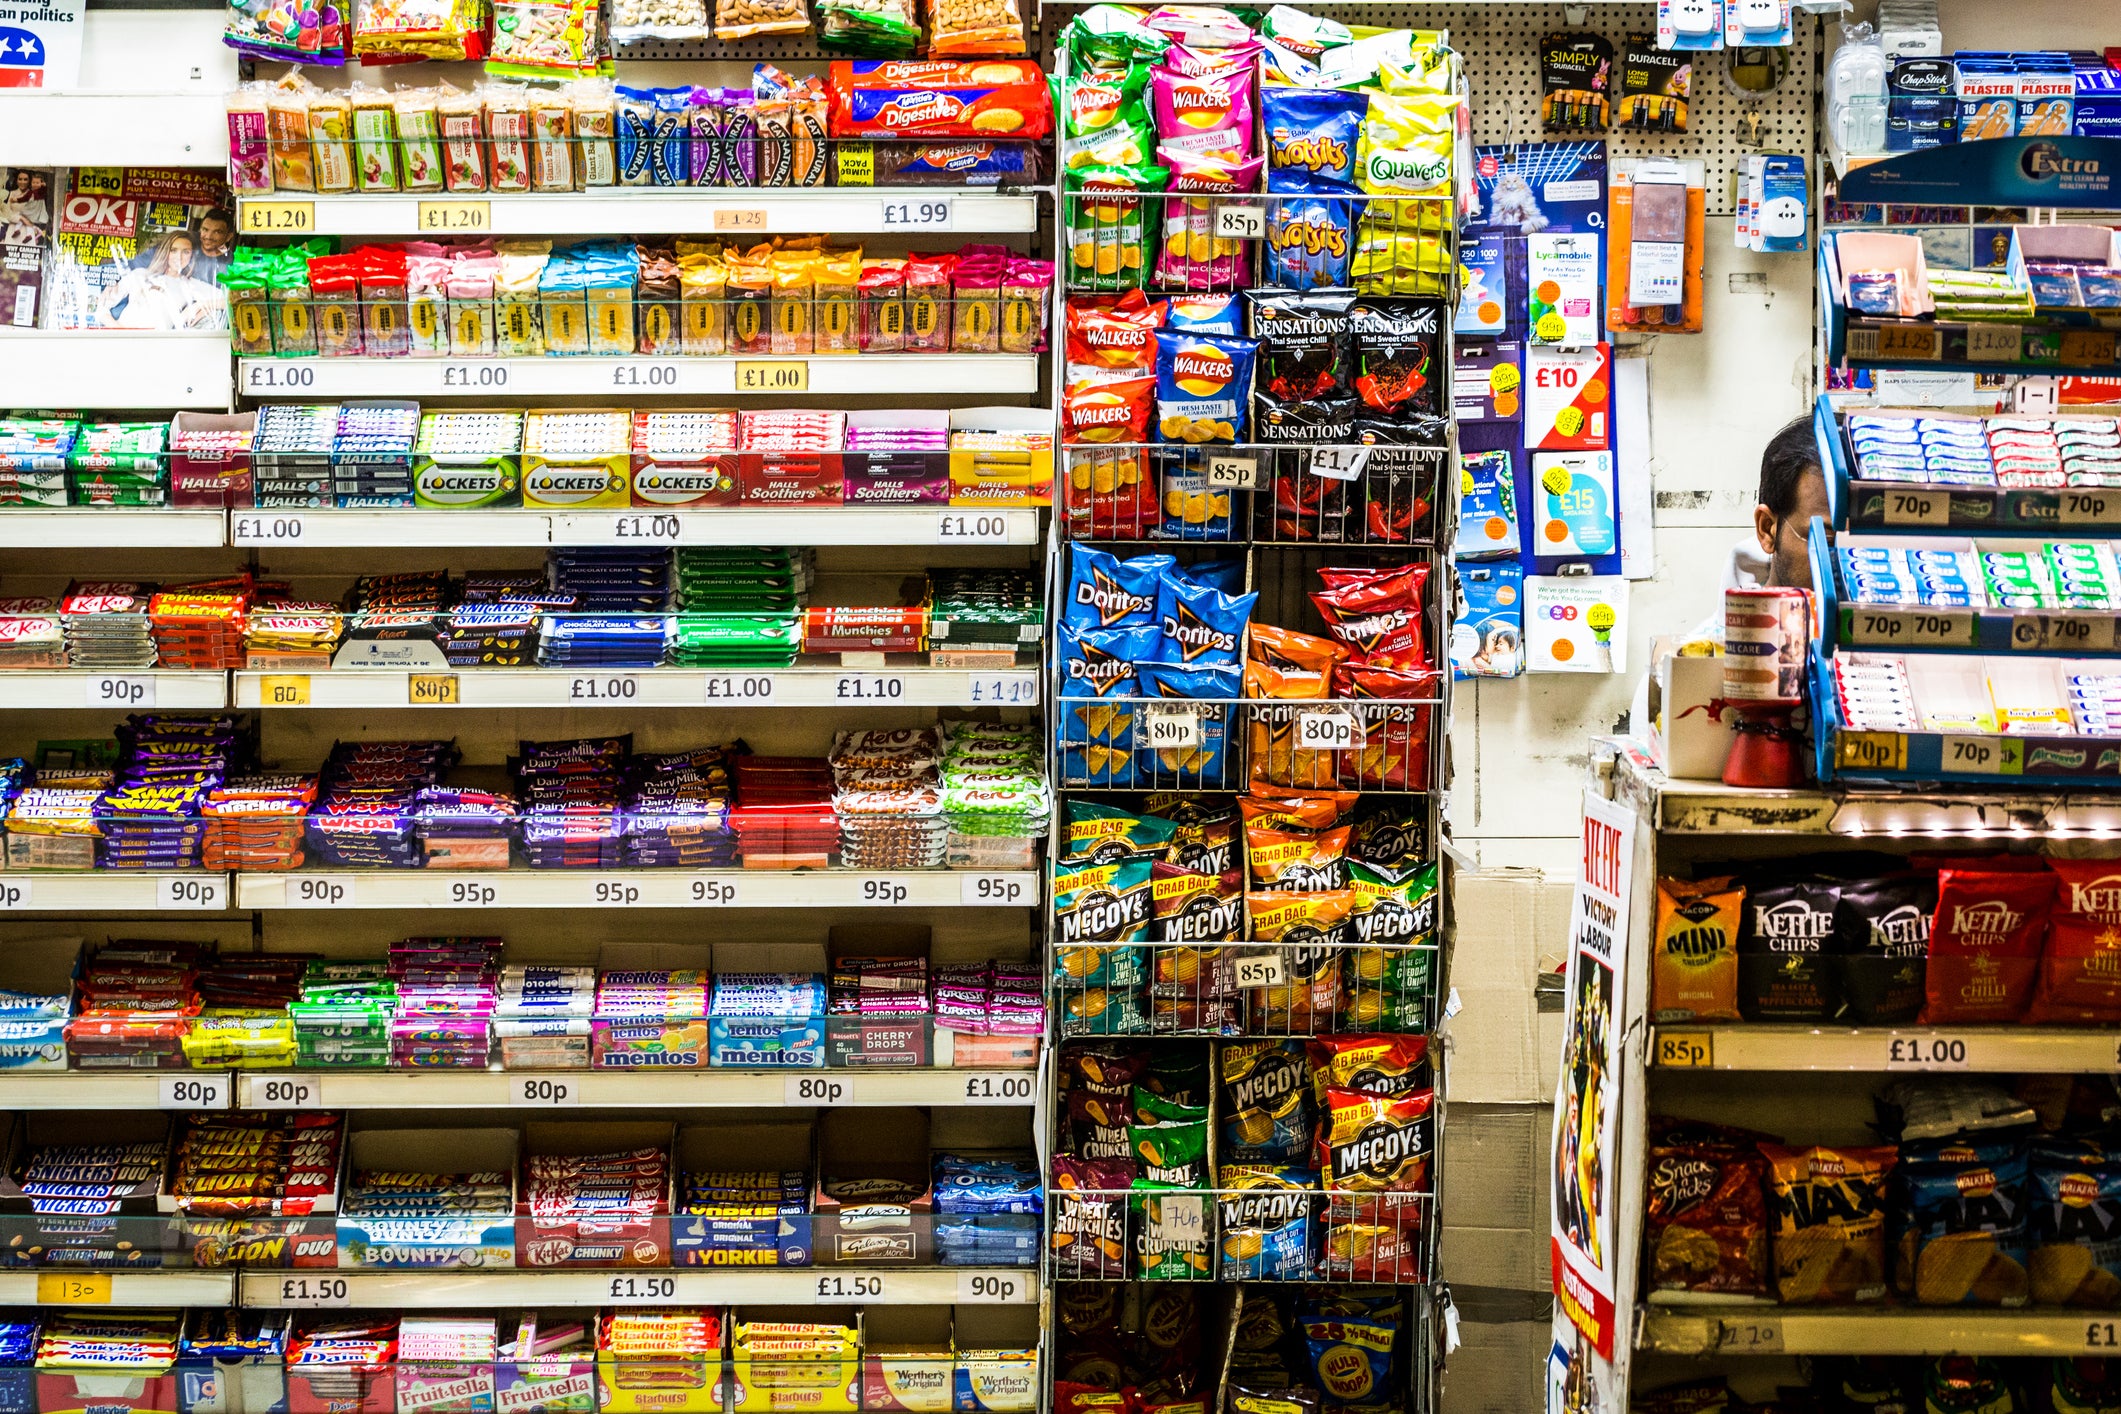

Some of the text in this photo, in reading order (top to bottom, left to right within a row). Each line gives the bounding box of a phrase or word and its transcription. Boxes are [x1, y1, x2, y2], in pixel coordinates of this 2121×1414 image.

[20, 8, 74, 23] politics
[1550, 51, 1599, 66] SIMPLY
[1629, 54, 1678, 66] DURACELL
[886, 62, 957, 79] Digestives
[1900, 74, 1947, 85] ChapStick
[1964, 85, 2013, 94] PLASTER
[2022, 85, 2071, 94] PLASTER
[1173, 92, 1231, 107] WALKERS
[1964, 104, 1976, 114] 16
[2022, 103, 2033, 114] 16
[235, 115, 247, 154] Smoothie
[2032, 151, 2099, 173] Extra
[80, 175, 120, 190] £1.80
[152, 179, 181, 189] ONLY
[66, 197, 135, 227] OK!
[251, 209, 306, 228] £1.20
[427, 209, 482, 228] £1.20
[885, 204, 947, 223] £1.99
[1223, 214, 1258, 234] 85p
[59, 234, 136, 250] PETER ANDRE
[1256, 315, 1345, 335] SENSATIONS
[1541, 323, 1563, 332] 99p
[1088, 331, 1146, 346] WALKERS
[1271, 336, 1326, 344] Thai Sweet Chilli
[251, 367, 314, 388] £1.00
[443, 367, 508, 388] £1.00
[613, 367, 677, 386] £1.00
[1175, 359, 1234, 377] WALKERS
[1536, 368, 1577, 387] £10
[744, 369, 799, 387] £1.00
[1260, 421, 1351, 437] SENSATIONS
[77, 457, 116, 468] TREBOR
[181, 477, 230, 489] HALLS
[422, 475, 496, 490] LOCKETS
[530, 475, 604, 490] LOCKETS
[639, 475, 713, 490] LOCKETS
[1214, 464, 1249, 485] 85p
[263, 481, 307, 492] HALLS
[750, 487, 816, 500] Soothers
[855, 487, 920, 500] Soothers
[960, 487, 1025, 500] Soothers
[1560, 489, 1595, 509] £15
[1895, 497, 1931, 516] 70p
[2069, 497, 2105, 516] 70p
[237, 519, 302, 538] £1.00
[615, 517, 680, 537] £1.00
[940, 517, 1005, 537] £1.00
[499, 593, 575, 604] SNICKERS
[1077, 583, 1153, 612] Doritos
[1593, 611, 1613, 621] 99p
[832, 625, 893, 637] Munchies
[1164, 617, 1235, 650] Doritos
[1865, 617, 1952, 637] 70p 70p
[2054, 618, 2090, 638] 70p
[1738, 645, 1760, 654] CARE
[101, 680, 144, 706] 90p
[416, 680, 450, 700] 80p
[572, 679, 636, 698] £1.00
[707, 679, 771, 697] £1.00
[837, 679, 901, 697] £1.10
[861, 731, 911, 746] Aero
[1155, 721, 1189, 742] 80p
[1305, 719, 1349, 743] 80p
[1849, 740, 1889, 763] 70p
[1953, 742, 1989, 763] 70p
[1070, 820, 1123, 837] GRAB BAG
[1603, 824, 1622, 898] EYE
[172, 881, 214, 905] 90p
[301, 881, 344, 904] 90p
[452, 883, 495, 904] 95p
[596, 883, 639, 904] 95p
[692, 882, 735, 903] 95p
[864, 881, 907, 902] 95p
[978, 879, 1021, 901] 95p
[1583, 894, 1617, 931] VICTORY
[1754, 905, 1834, 938] KETTLE
[1950, 904, 2023, 935] KETTLE
[1580, 921, 1611, 959] LABOUR
[1667, 926, 1726, 955] MINI
[1770, 938, 1819, 951] CHIPS
[1961, 933, 2006, 945] CHIPS
[1240, 965, 1277, 985] 85p
[792, 1038, 813, 1049] mint
[866, 1032, 912, 1041] CHERRY
[866, 1040, 905, 1049] DROPS
[604, 1052, 697, 1065] mentos
[721, 1051, 814, 1064] mentos
[1663, 1042, 1704, 1063] 85p
[1890, 1040, 1965, 1063] £1.00
[174, 1082, 216, 1105] 80p
[266, 1082, 308, 1104] 80p
[524, 1081, 567, 1103] 80p
[799, 1080, 842, 1102] 80p
[967, 1079, 1030, 1097] £1.00
[1147, 1166, 1190, 1182] WHEAT
[1167, 1206, 1200, 1227] 70p
[226, 1238, 334, 1259] LION DUO
[850, 1237, 891, 1253] Galaxy
[366, 1247, 453, 1263] BOUNTY
[699, 1250, 803, 1265] YORKIE DUO
[283, 1280, 346, 1299] £1.50
[611, 1279, 674, 1297] £1.50
[818, 1277, 882, 1296] £1.50
[972, 1277, 1015, 1300] 90p
[71, 1354, 147, 1363] Milkybar
[302, 1352, 365, 1364] Daim
[1328, 1357, 1359, 1374] HULA
[895, 1370, 945, 1381] Werther's
[908, 1379, 943, 1388] Original
[1330, 1369, 1369, 1393] HOOPS
